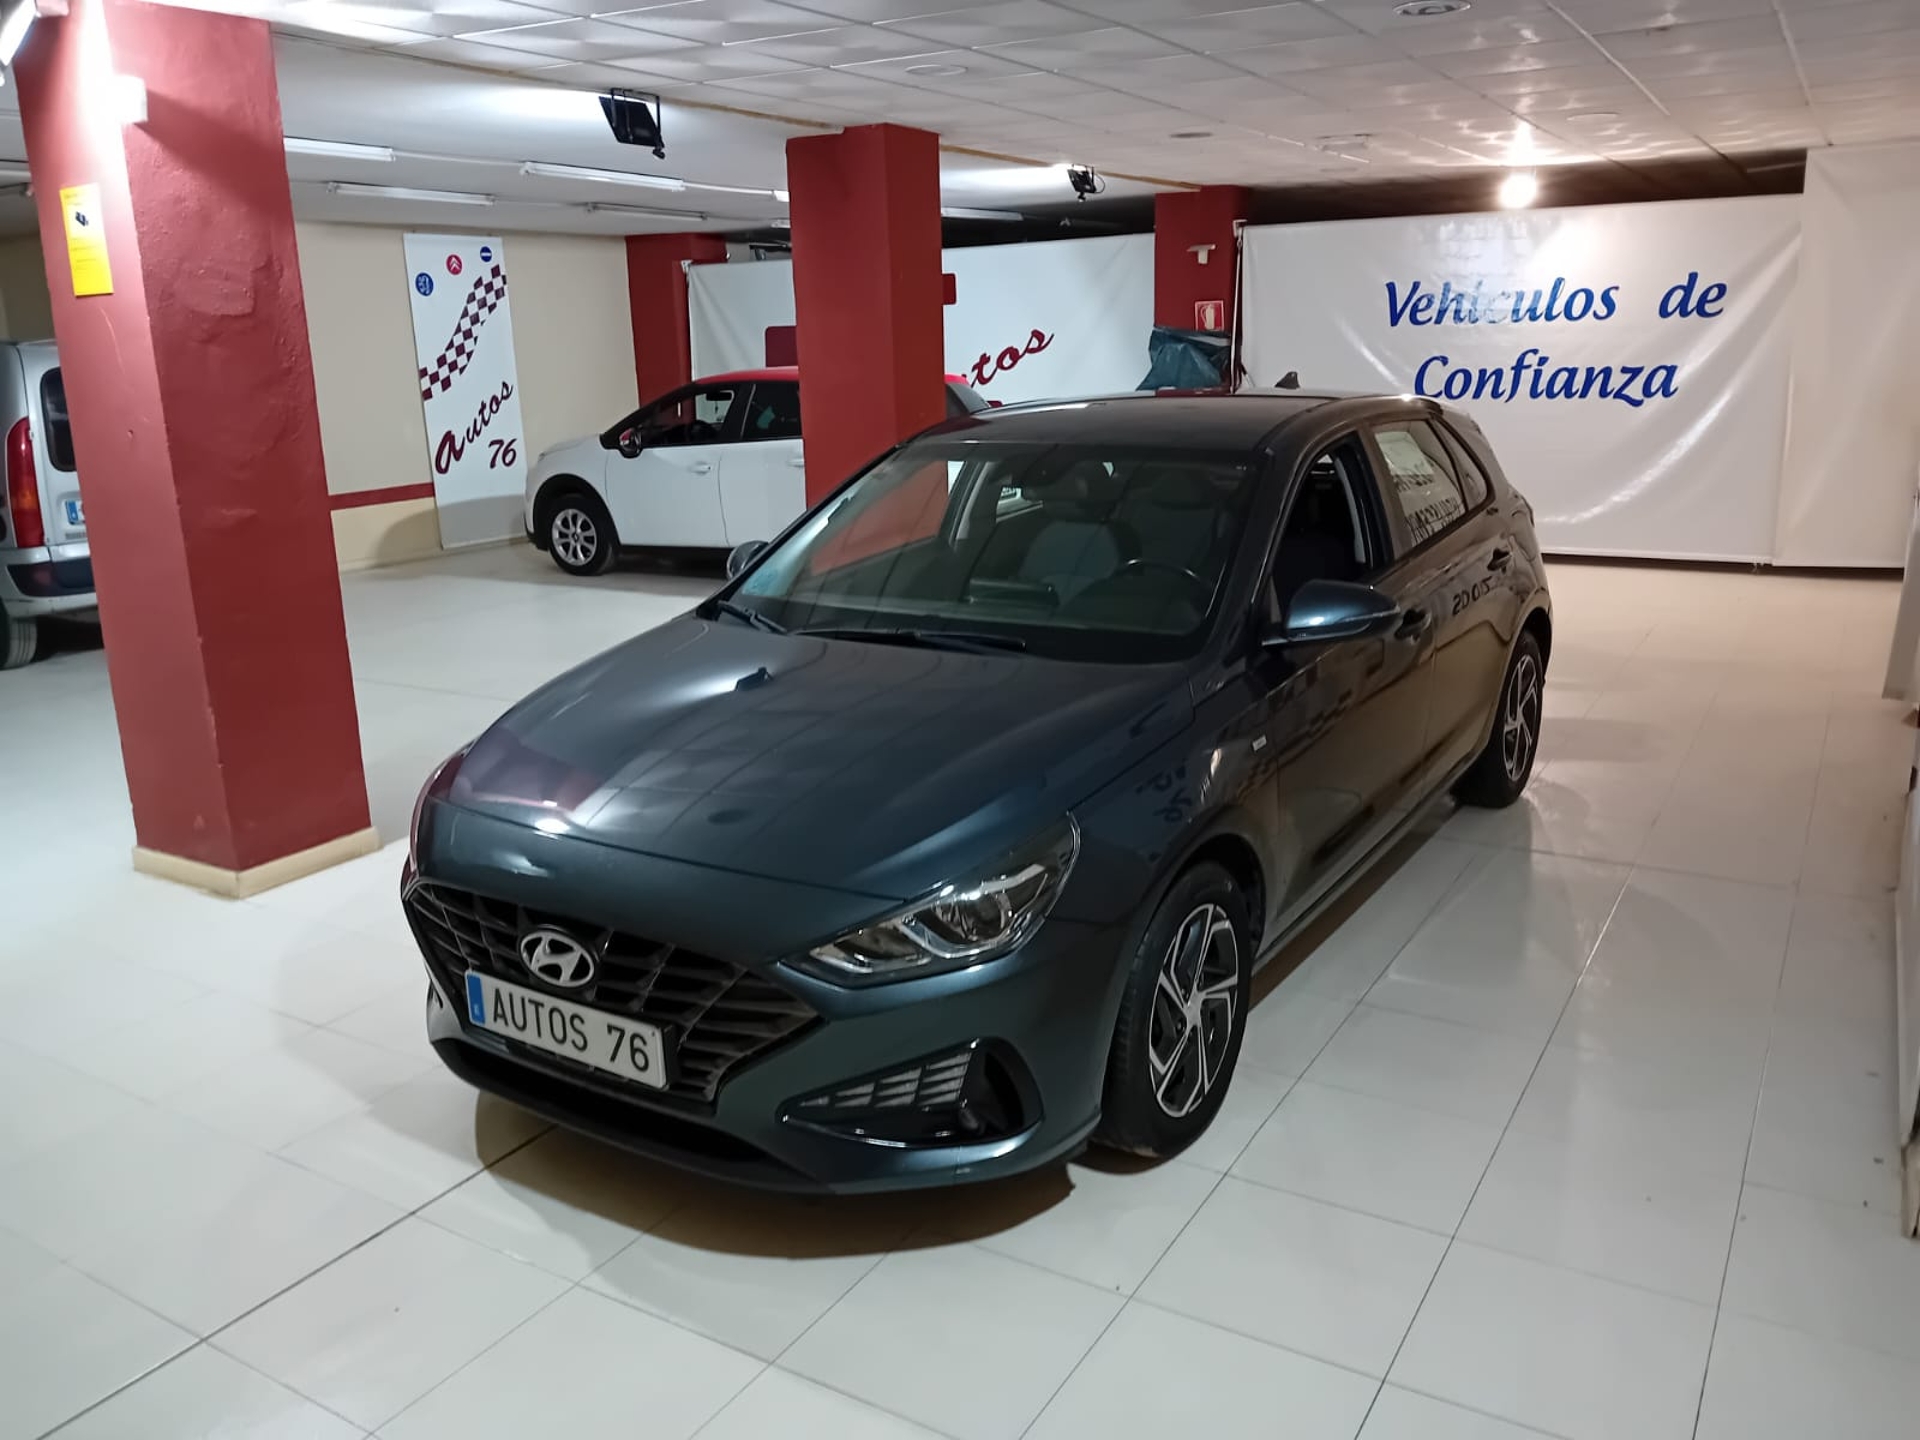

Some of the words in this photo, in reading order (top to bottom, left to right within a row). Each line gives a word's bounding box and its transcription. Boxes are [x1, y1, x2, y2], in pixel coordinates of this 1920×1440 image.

[1658, 271, 1728, 319] de
[962, 328, 1055, 389] tos
[1413, 348, 1679, 408] Confianza
[487, 438, 518, 469] 76
[492, 987, 589, 1052] AUTOS
[606, 1023, 650, 1073] 76
